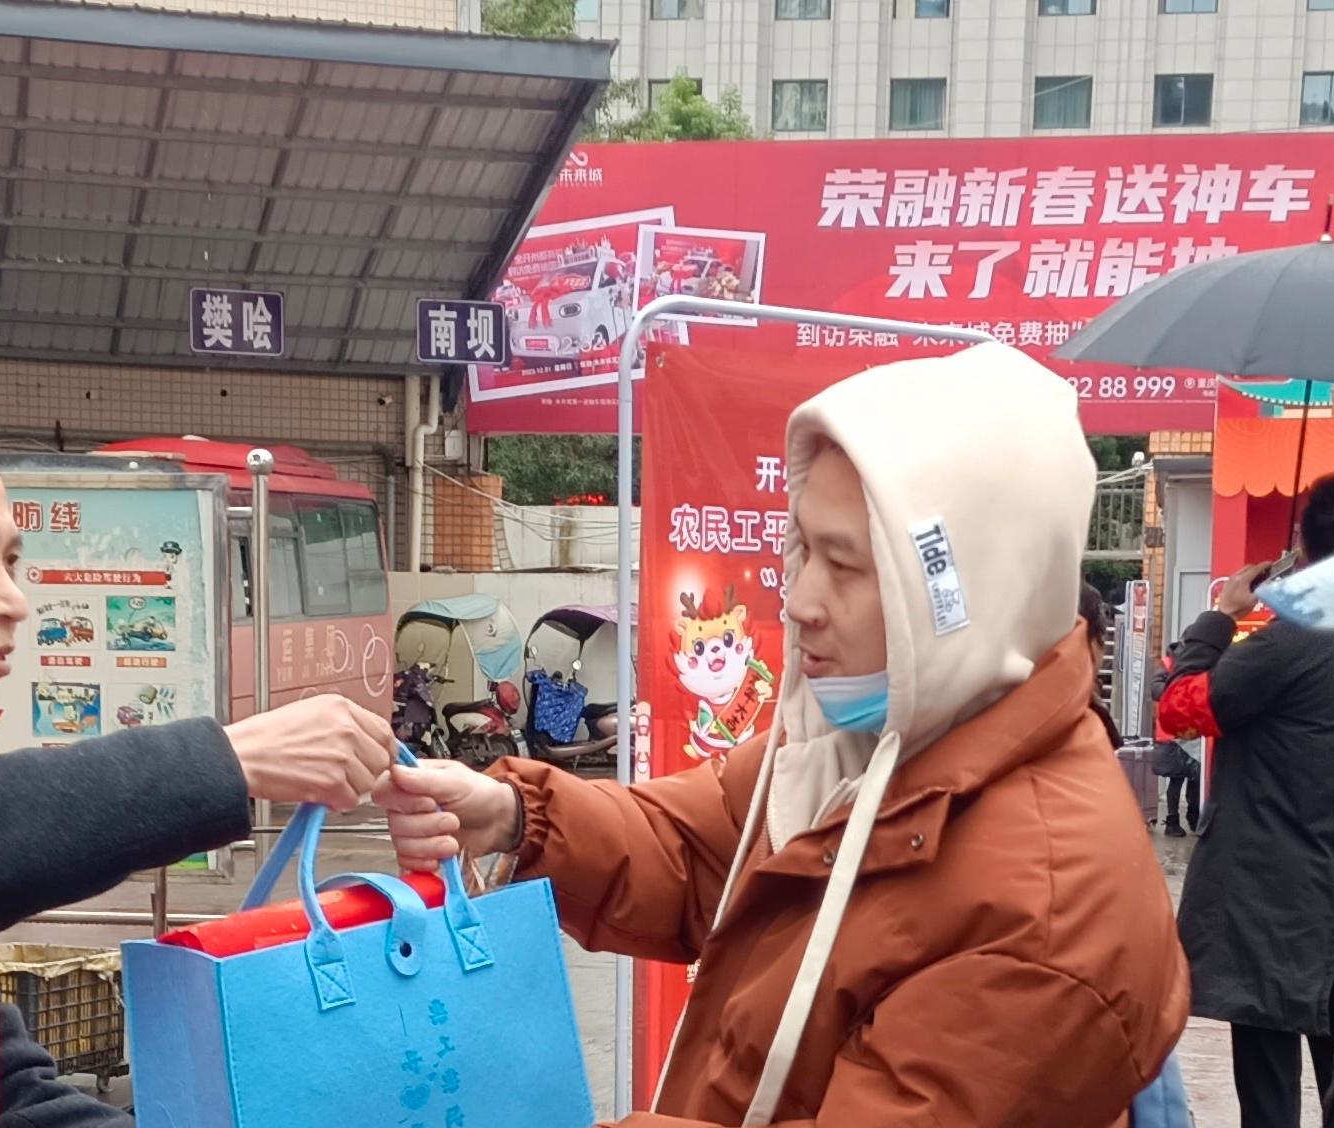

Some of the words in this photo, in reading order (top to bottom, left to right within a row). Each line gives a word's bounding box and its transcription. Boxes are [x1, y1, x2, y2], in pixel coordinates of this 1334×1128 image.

[817, 163, 1316, 228] 荣融新春送神车
[201, 293, 273, 350] 樊哙
[428, 304, 495, 359] 南坝
[1098, 376, 1127, 398] 88
[1133, 376, 1176, 398] 999
[755, 455, 788, 492] 开
